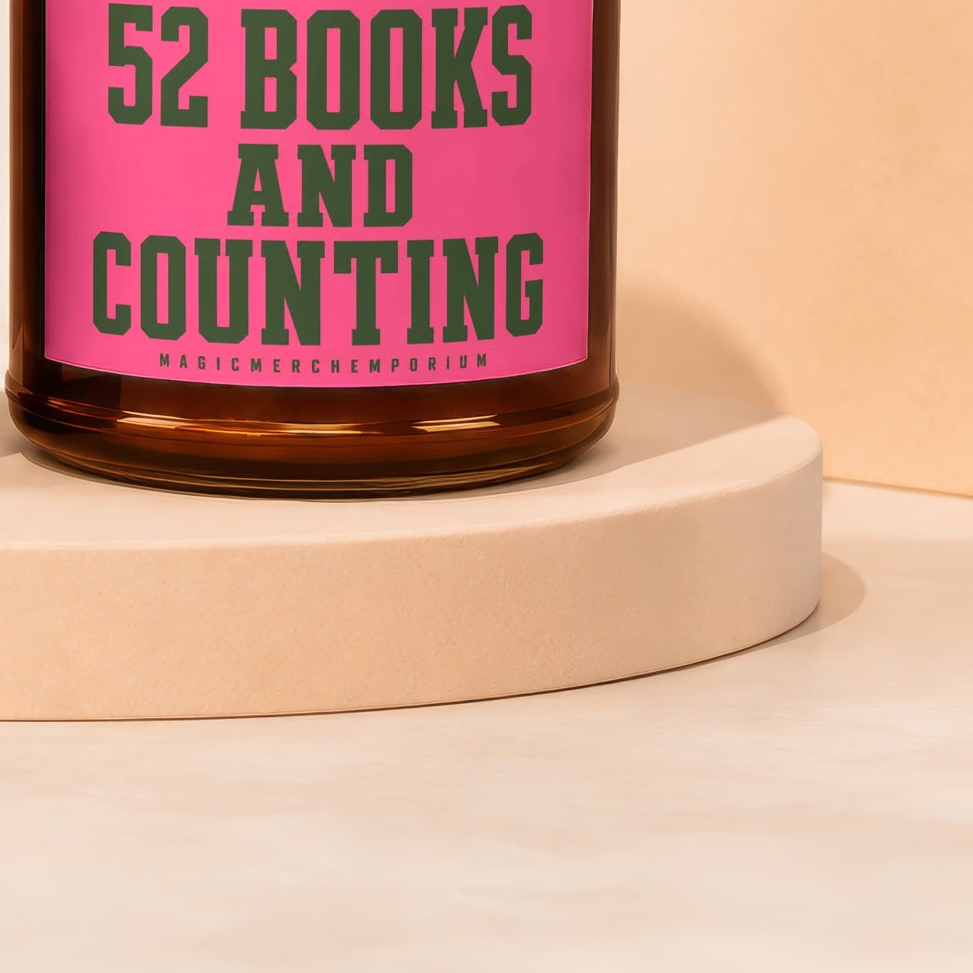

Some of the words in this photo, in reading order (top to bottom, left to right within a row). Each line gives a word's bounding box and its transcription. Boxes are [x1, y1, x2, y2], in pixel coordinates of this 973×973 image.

[107, 2, 209, 128] 52
[240, 4, 533, 131] BOOKS
[226, 143, 414, 228] AND
[92, 231, 544, 346] COUNTING
[159, 353, 489, 374] MAGICMERCHEMPORIUM
